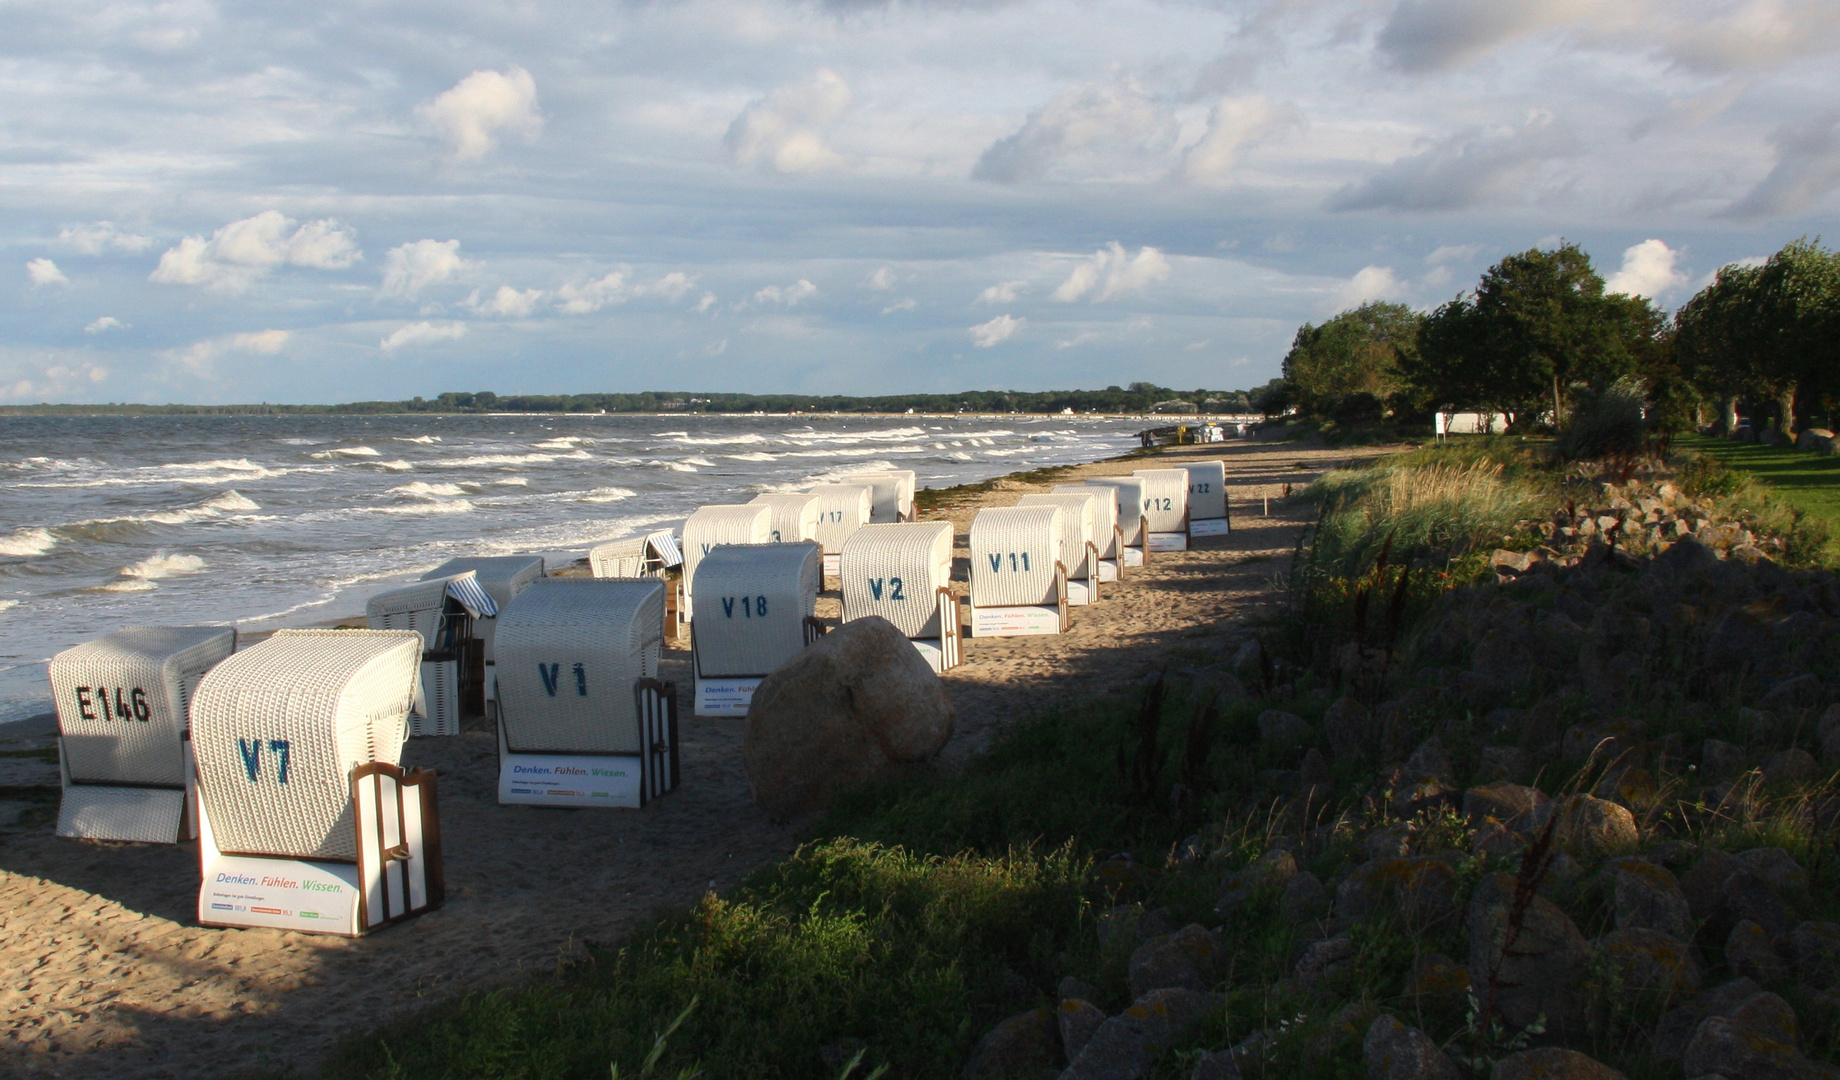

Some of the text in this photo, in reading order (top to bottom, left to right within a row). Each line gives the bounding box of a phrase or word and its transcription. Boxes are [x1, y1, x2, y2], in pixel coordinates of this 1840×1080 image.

[513, 765, 629, 778] Denken. Fühlen. Wissen.
[216, 872, 343, 893] Denken. Fühlen. Wissen.
